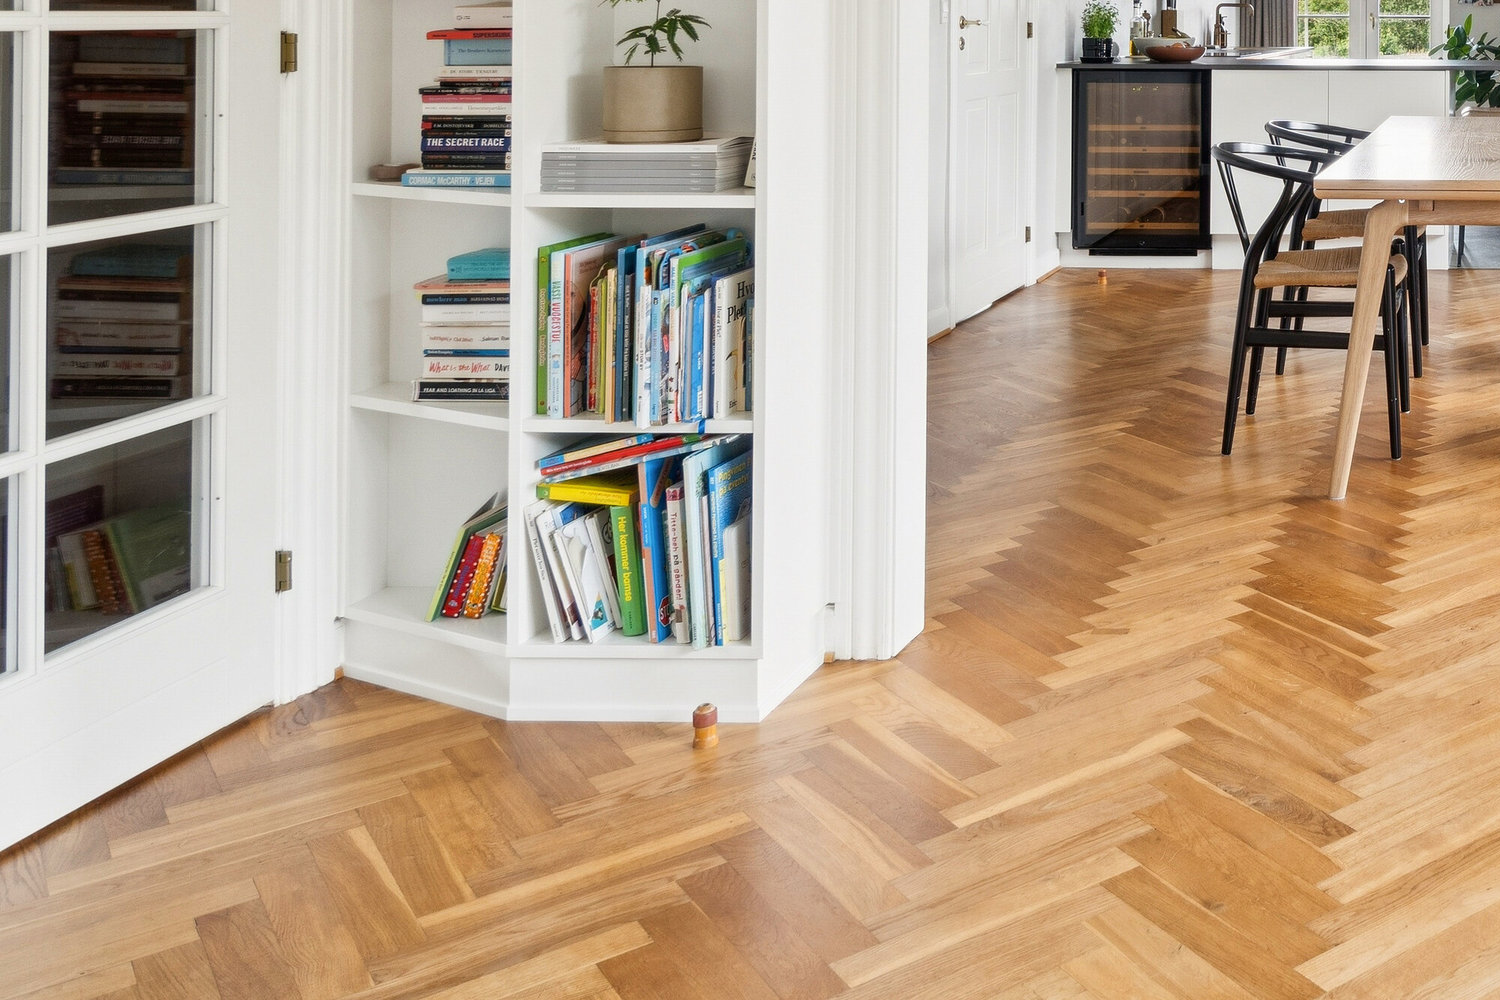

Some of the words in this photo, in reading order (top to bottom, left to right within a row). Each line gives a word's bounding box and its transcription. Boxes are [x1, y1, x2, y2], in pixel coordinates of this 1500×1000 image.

[427, 138, 443, 146] THE
[445, 138, 478, 146] SECRET
[482, 138, 504, 146] RACE
[437, 176, 470, 184] McCARTHY
[475, 176, 495, 184] VEJEN
[618, 516, 626, 534] Her
[620, 536, 630, 570] kommer
[624, 571, 632, 601] bamse
